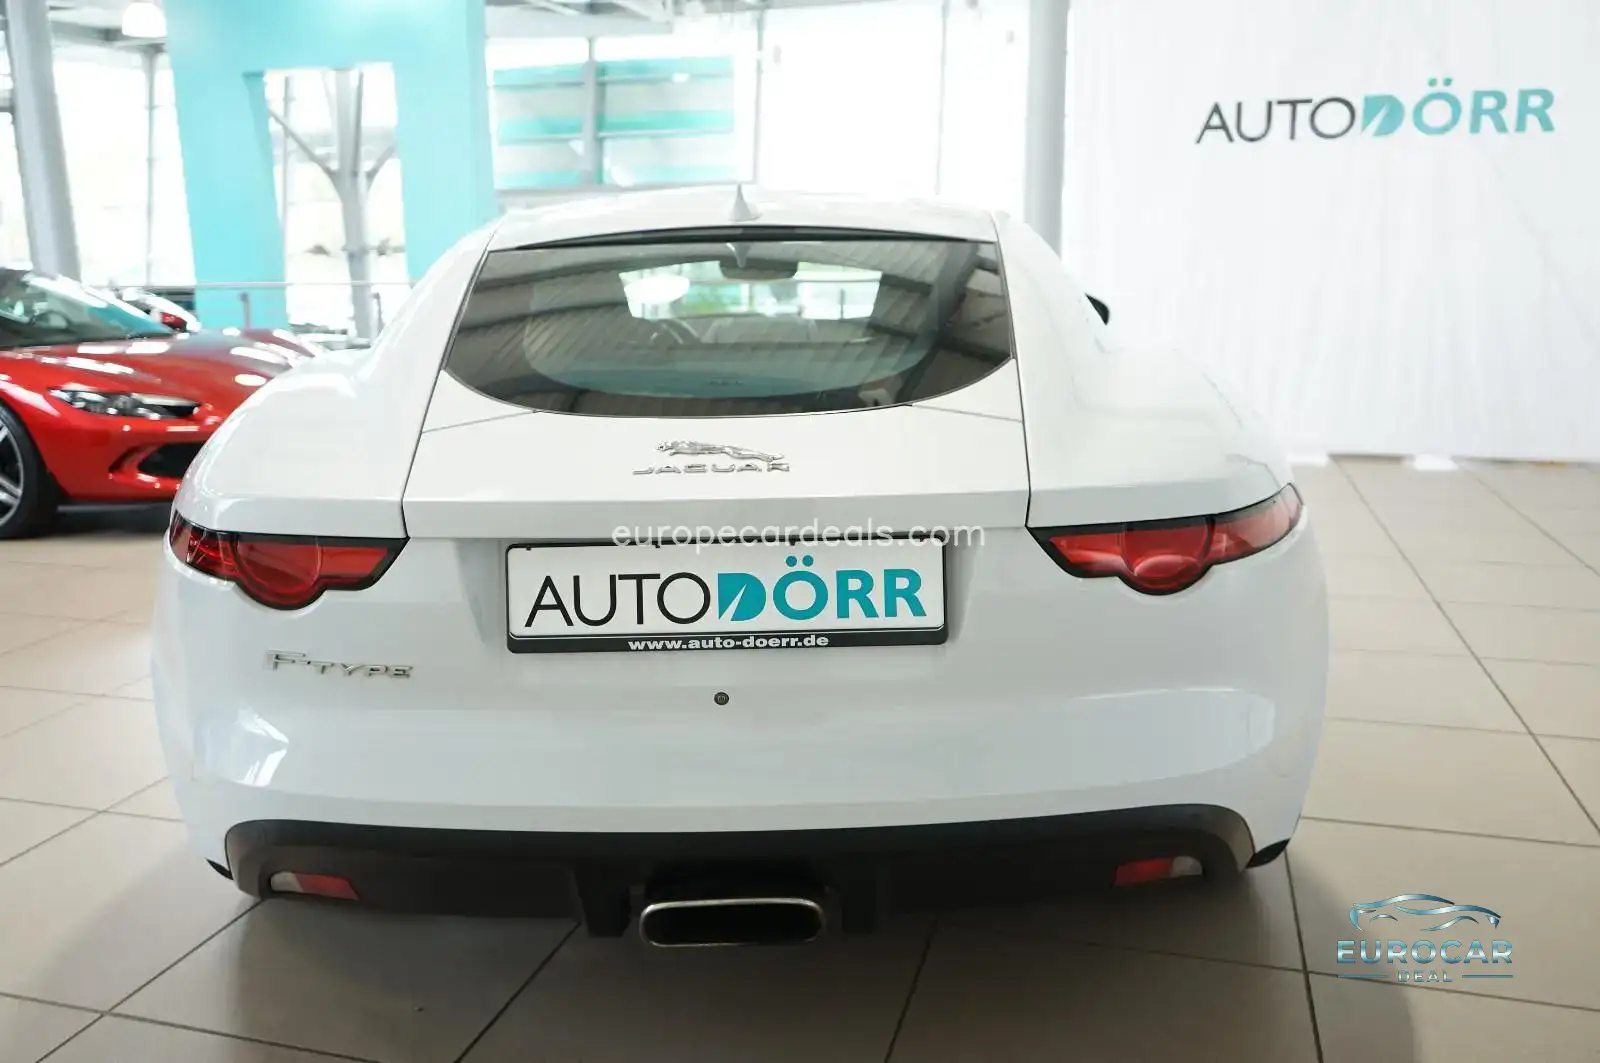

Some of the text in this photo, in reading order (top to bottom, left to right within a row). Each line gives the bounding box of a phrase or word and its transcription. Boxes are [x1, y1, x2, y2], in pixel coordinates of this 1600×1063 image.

[633, 463, 790, 475] JAGUAR
[628, 634, 829, 650] www.auto-doerr.de
[264, 649, 414, 678] F-TYPE
